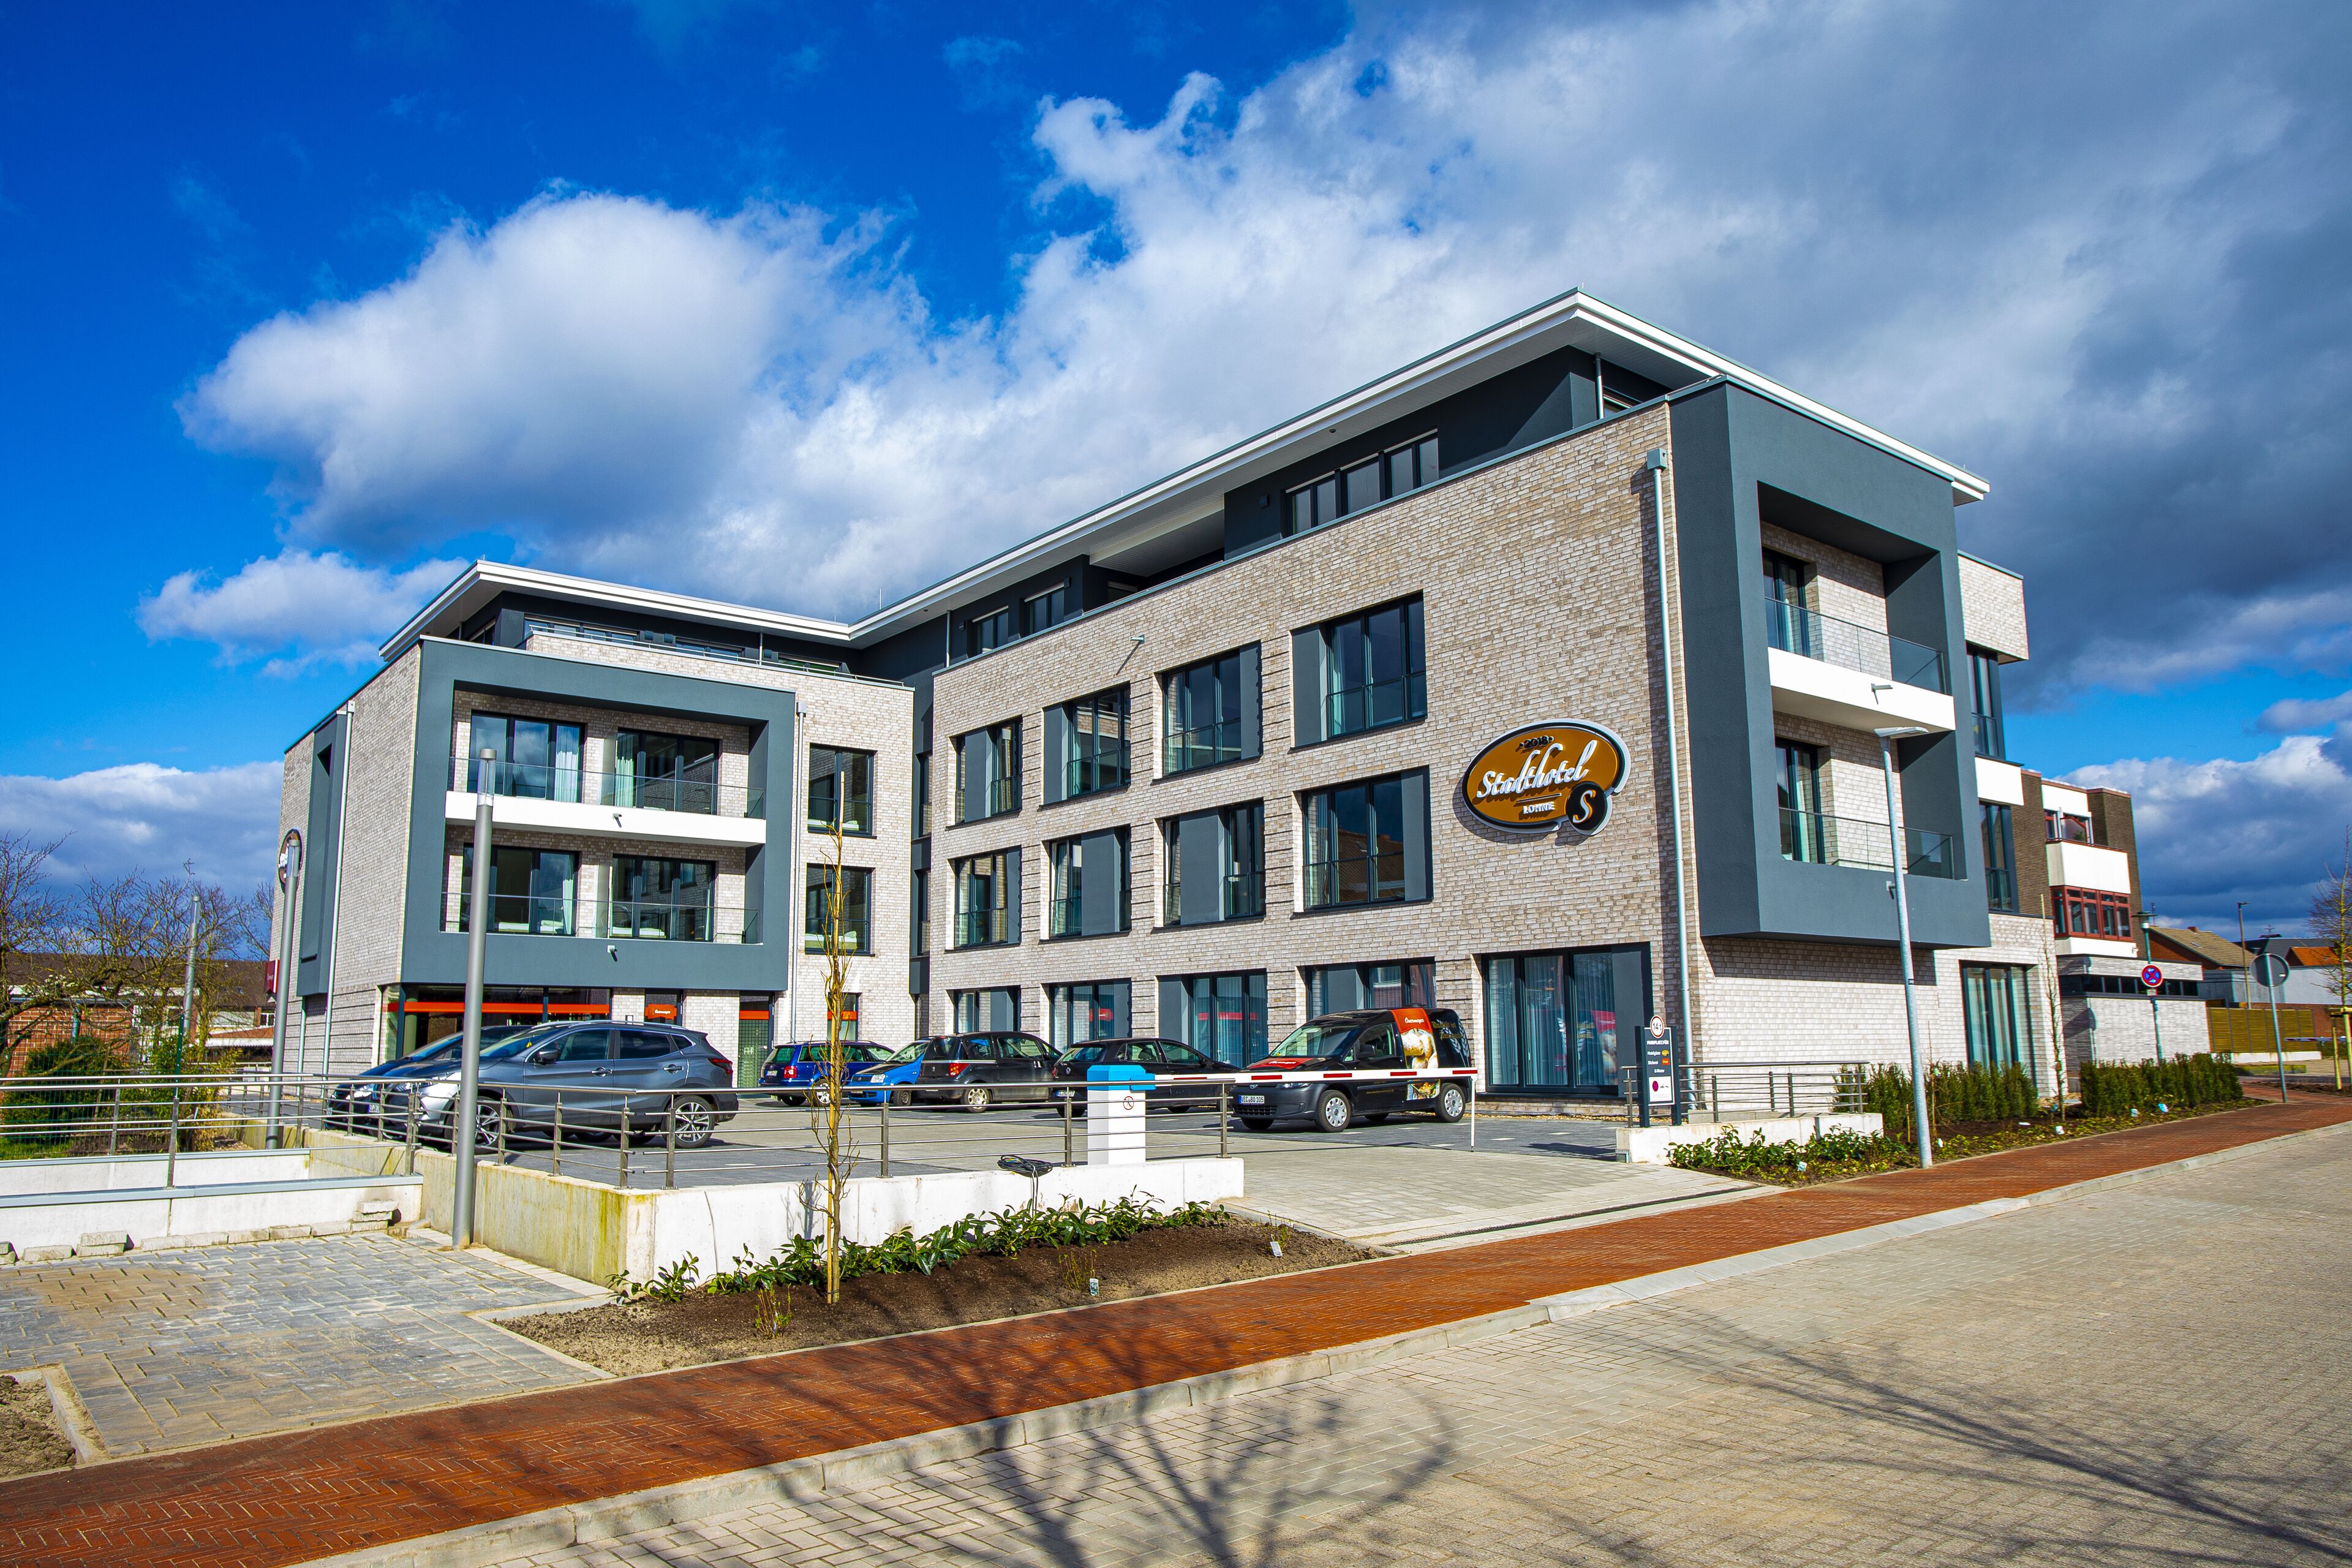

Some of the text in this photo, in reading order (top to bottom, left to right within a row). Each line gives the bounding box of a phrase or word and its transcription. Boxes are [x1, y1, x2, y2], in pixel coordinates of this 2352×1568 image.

[1476, 739, 1597, 798] Stadthotel
[1523, 801, 1555, 814] LOHNE
[1572, 790, 1596, 823] S
